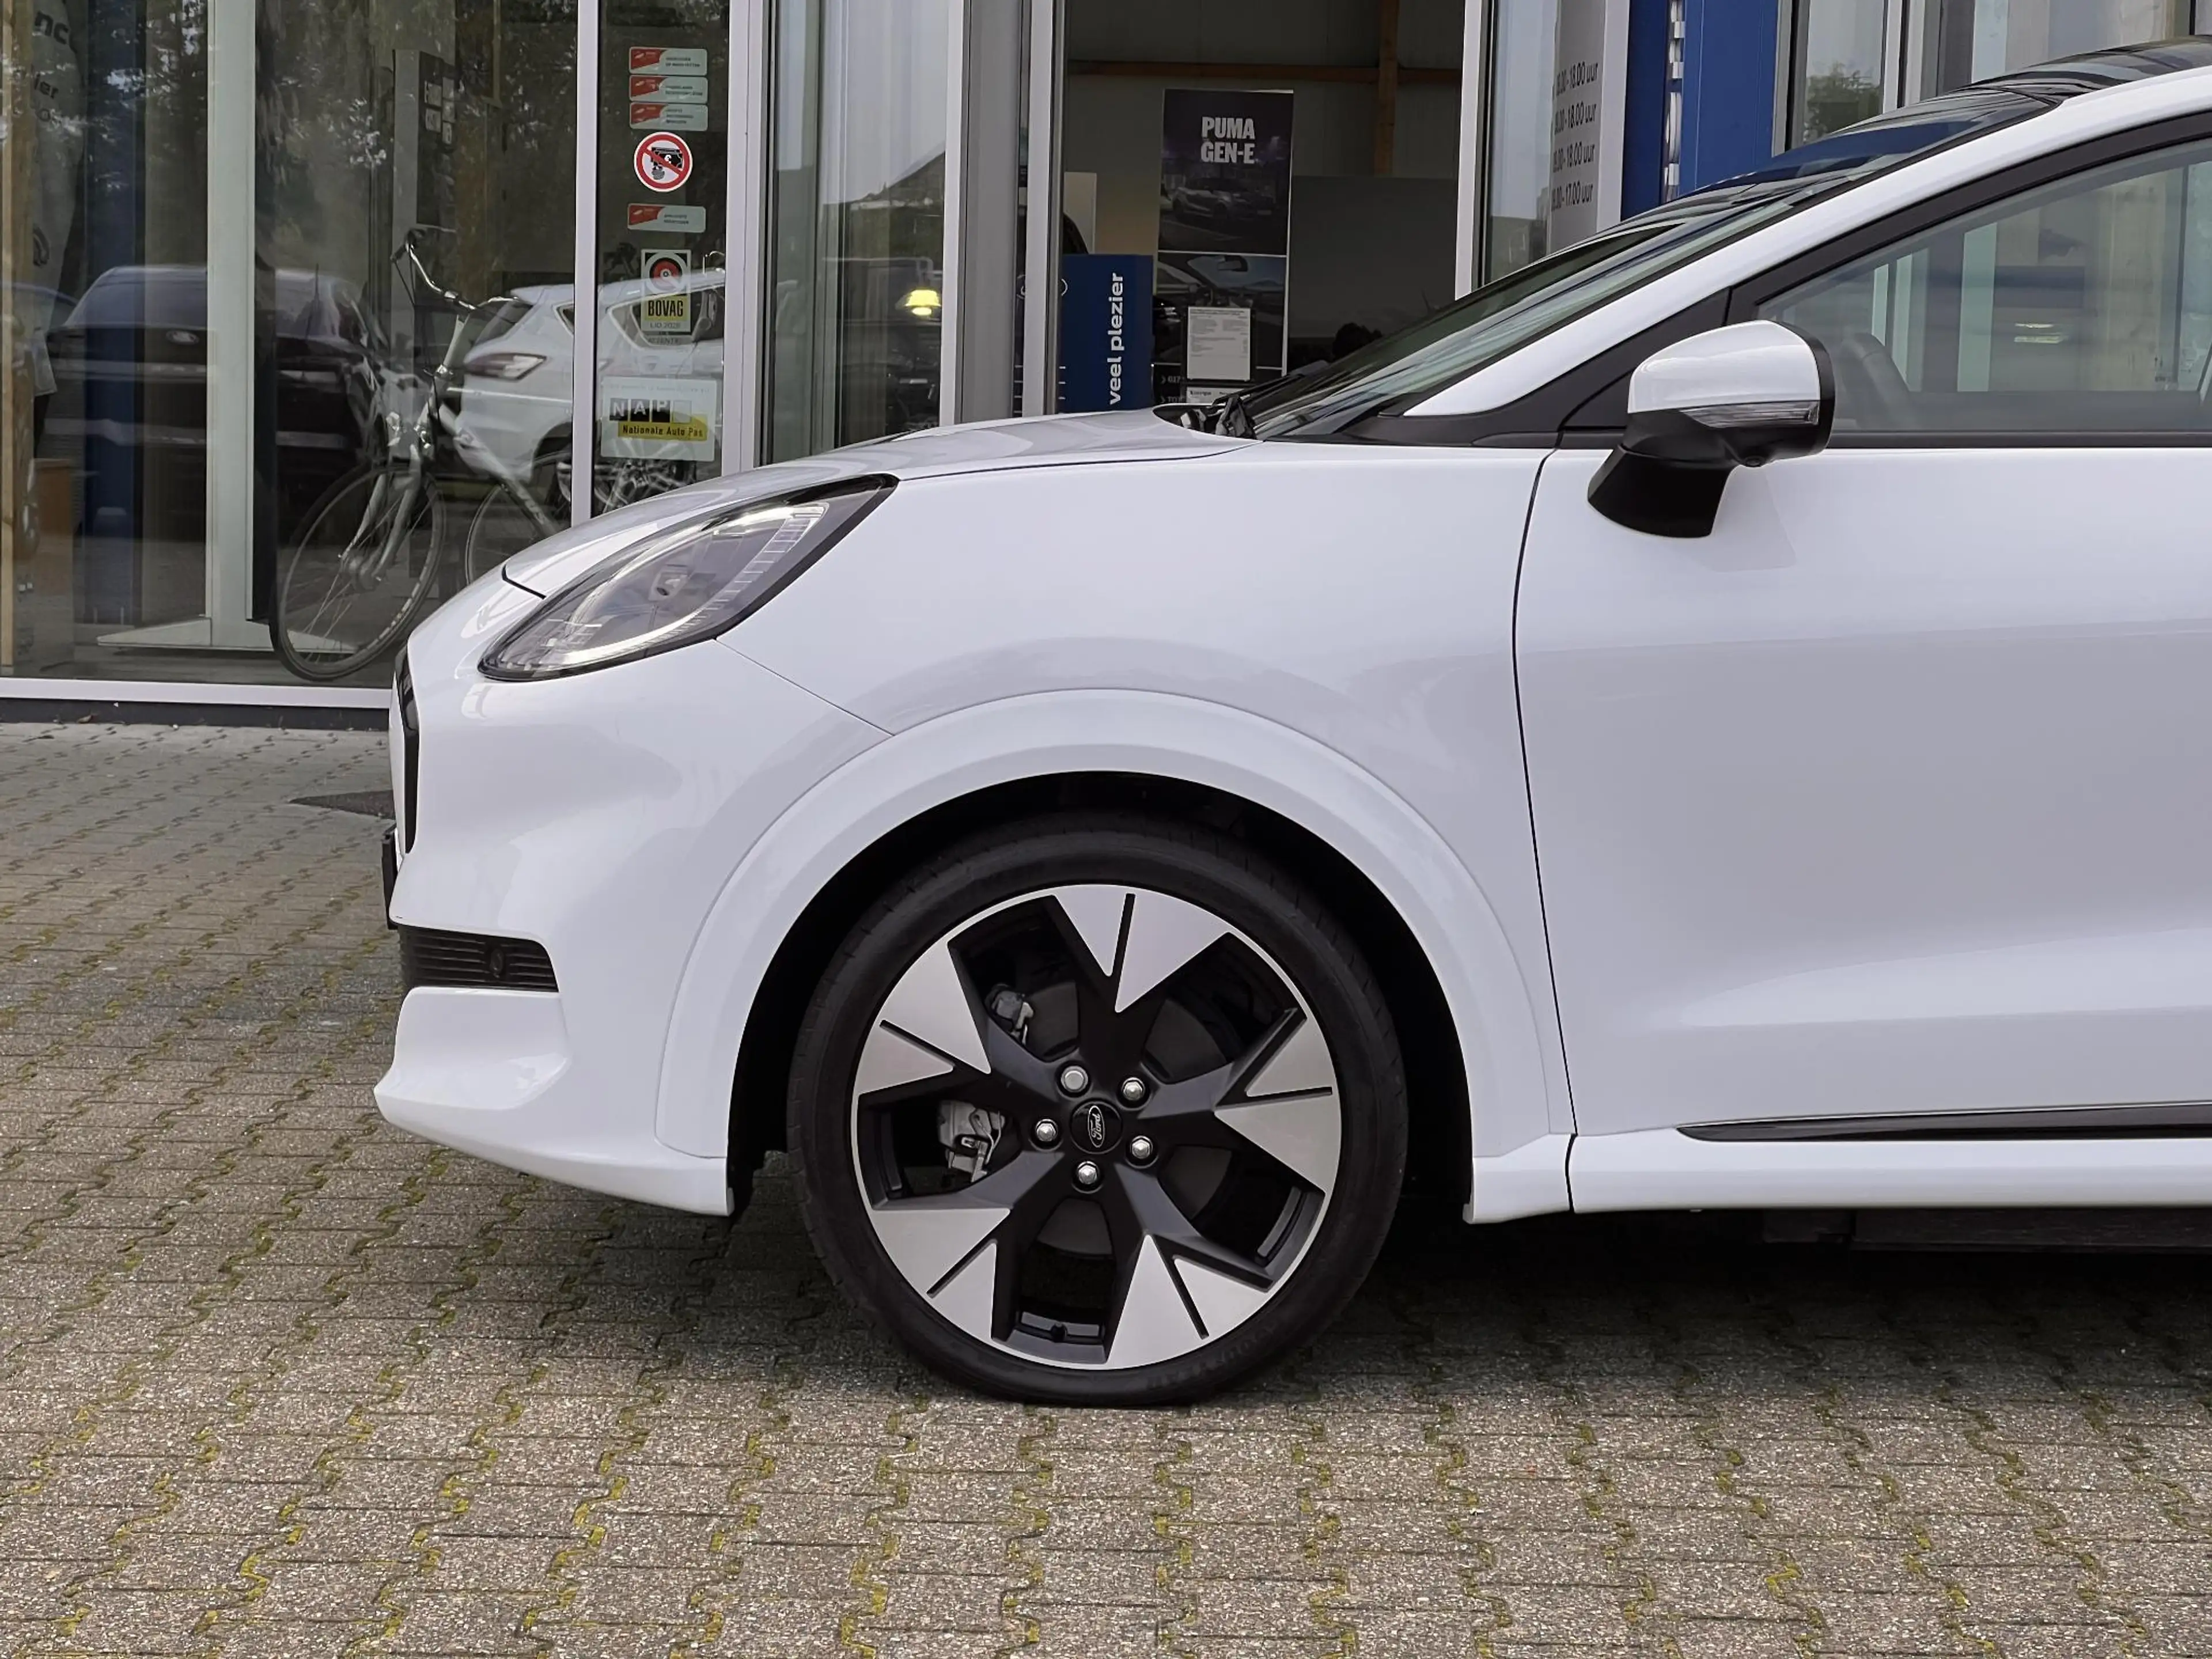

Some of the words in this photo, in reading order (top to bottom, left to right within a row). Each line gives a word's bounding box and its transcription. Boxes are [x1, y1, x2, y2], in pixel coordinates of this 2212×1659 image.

[1201, 116, 1255, 139] PUMA
[1200, 141, 1255, 164] GEN-E
[647, 300, 684, 317] BOVAG
[1108, 272, 1124, 351] plezier
[1107, 356, 1122, 405] veel
[623, 424, 664, 435] Nationale
[666, 426, 685, 436] Auto
